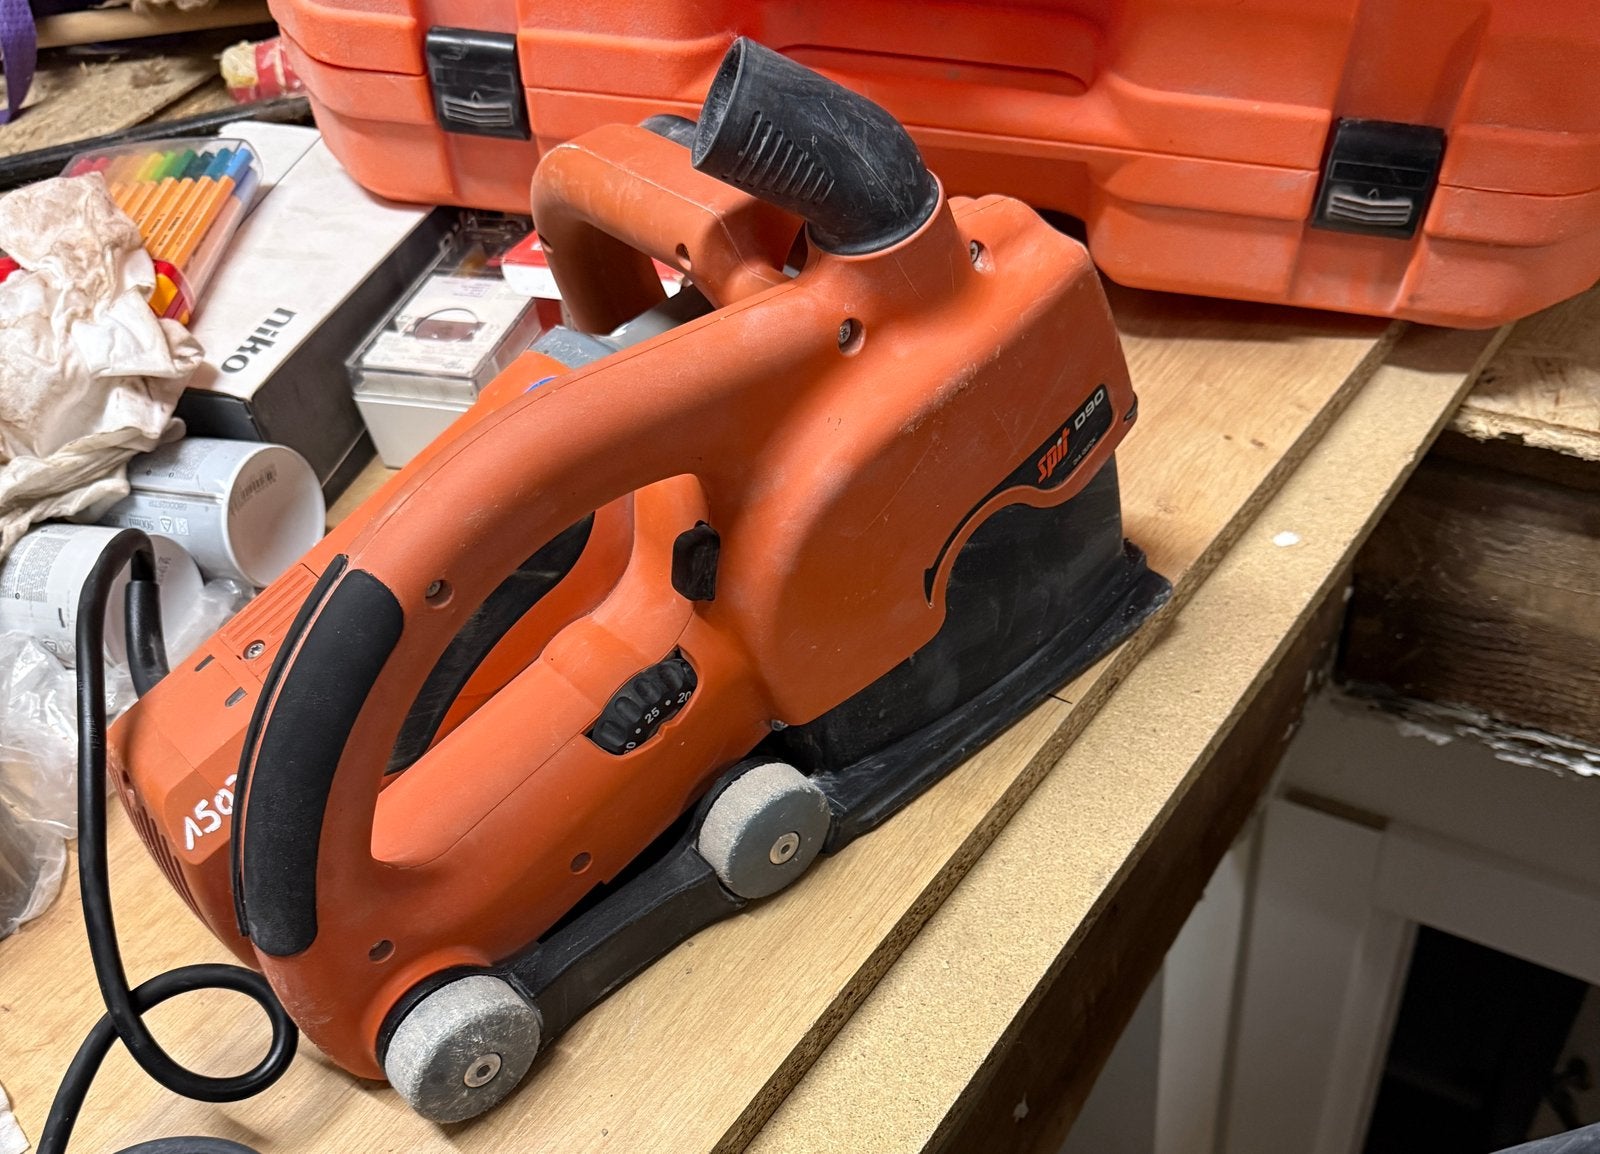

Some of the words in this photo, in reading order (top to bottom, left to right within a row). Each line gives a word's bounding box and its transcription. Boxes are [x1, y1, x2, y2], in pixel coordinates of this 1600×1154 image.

[221, 307, 297, 373] niko
[1074, 388, 1105, 431] D90
[623, 741, 636, 754] 0
[644, 706, 661, 724] 25
[677, 690, 692, 704] 20
